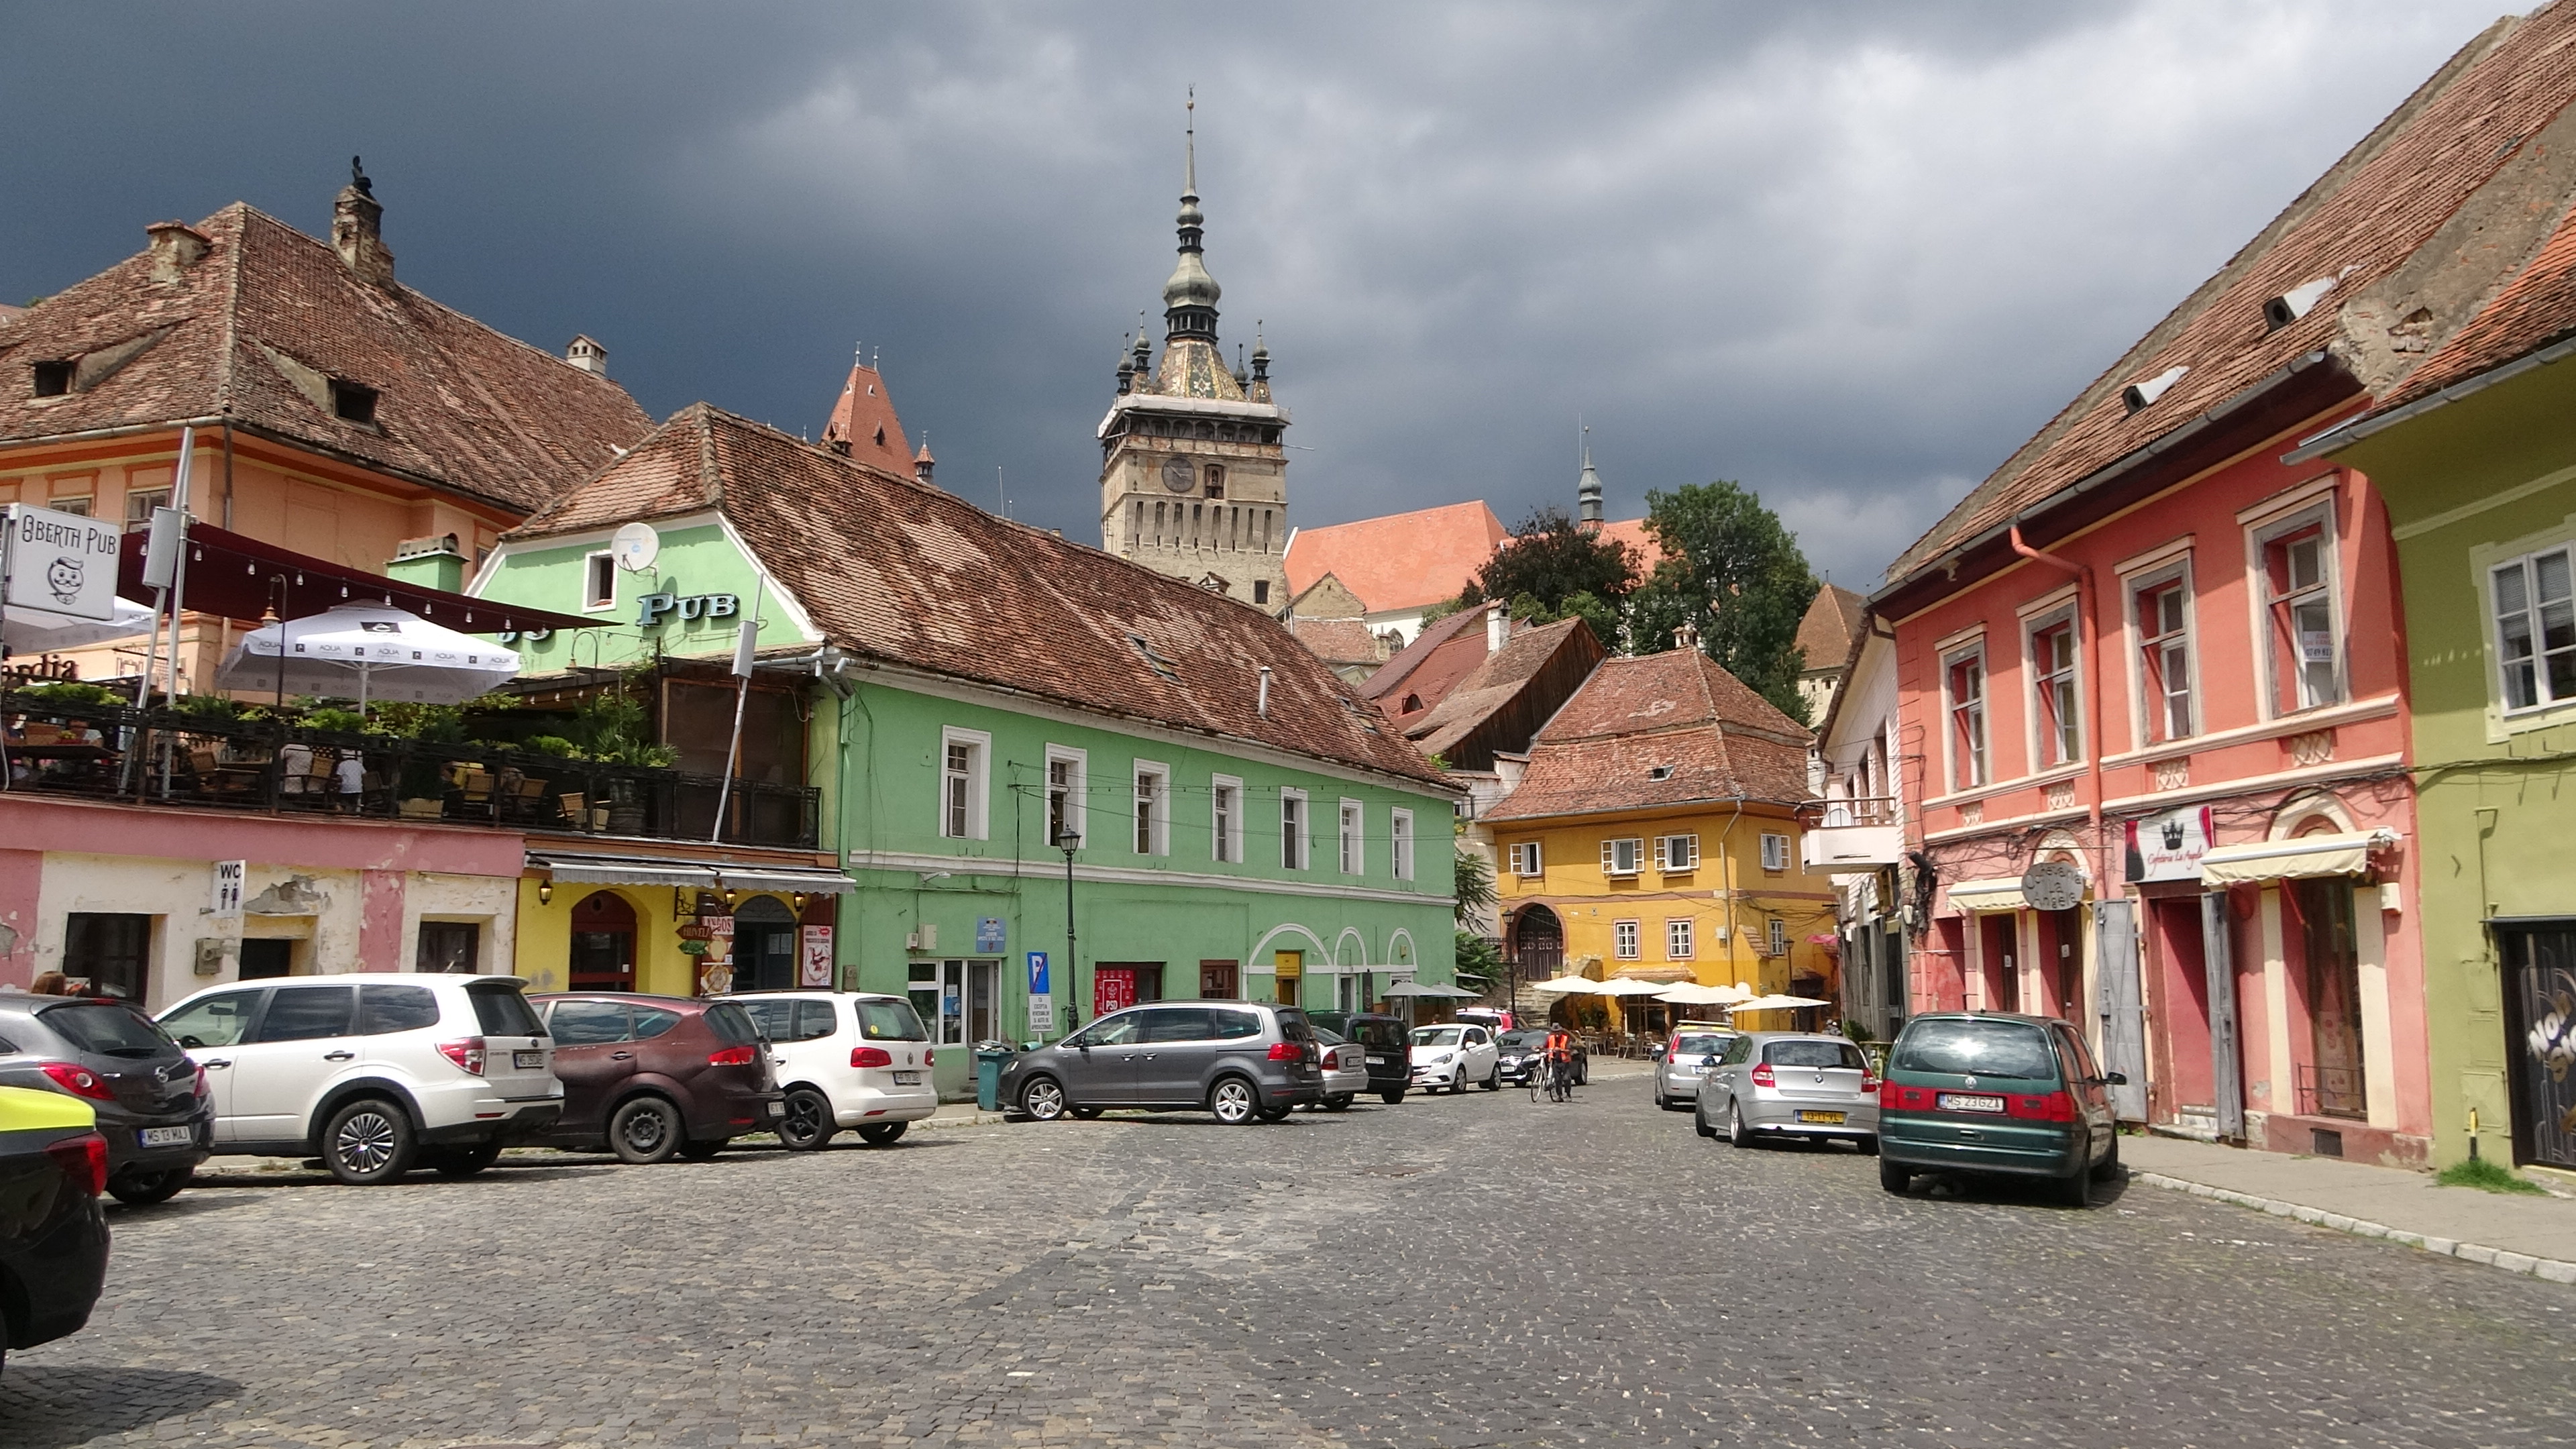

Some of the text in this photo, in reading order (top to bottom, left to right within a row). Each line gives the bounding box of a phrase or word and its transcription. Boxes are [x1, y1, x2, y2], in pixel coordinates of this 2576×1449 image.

[636, 592, 740, 627] PUB
[435, 652, 456, 660] AQUA
[220, 863, 241, 879] WC
[1106, 1000, 1118, 1010] PSD
[1946, 1095, 1961, 1106] MS
